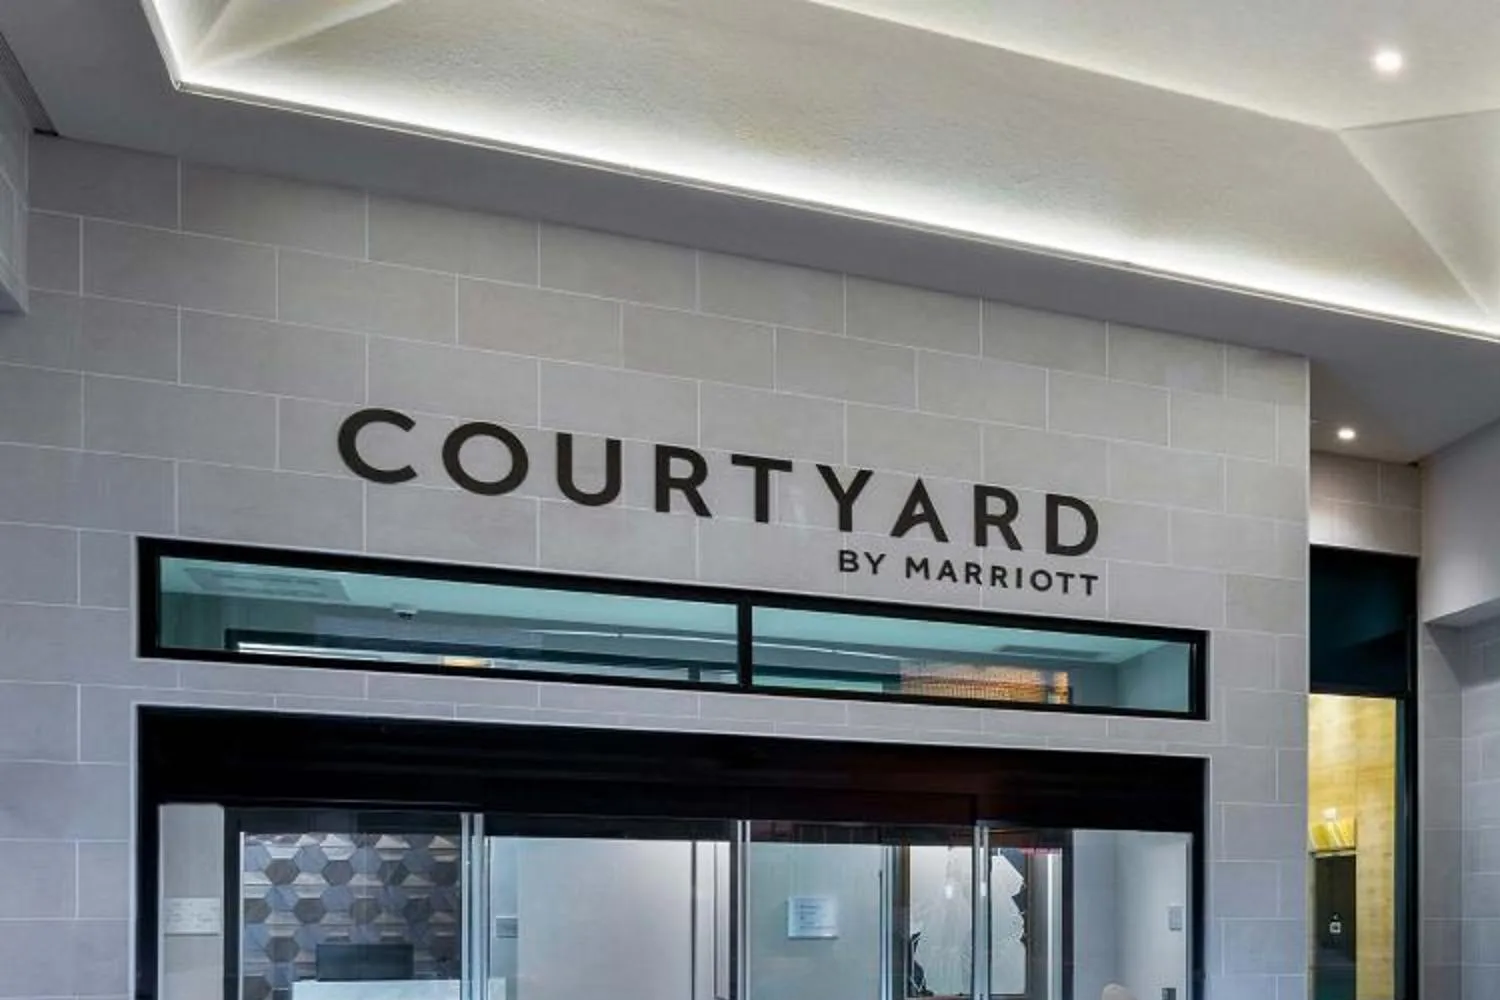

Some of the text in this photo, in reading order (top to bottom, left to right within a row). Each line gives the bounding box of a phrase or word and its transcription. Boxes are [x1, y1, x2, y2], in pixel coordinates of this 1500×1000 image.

[337, 407, 1099, 557] COURTYARD
[838, 550, 1099, 596] BY MARRIOTT
